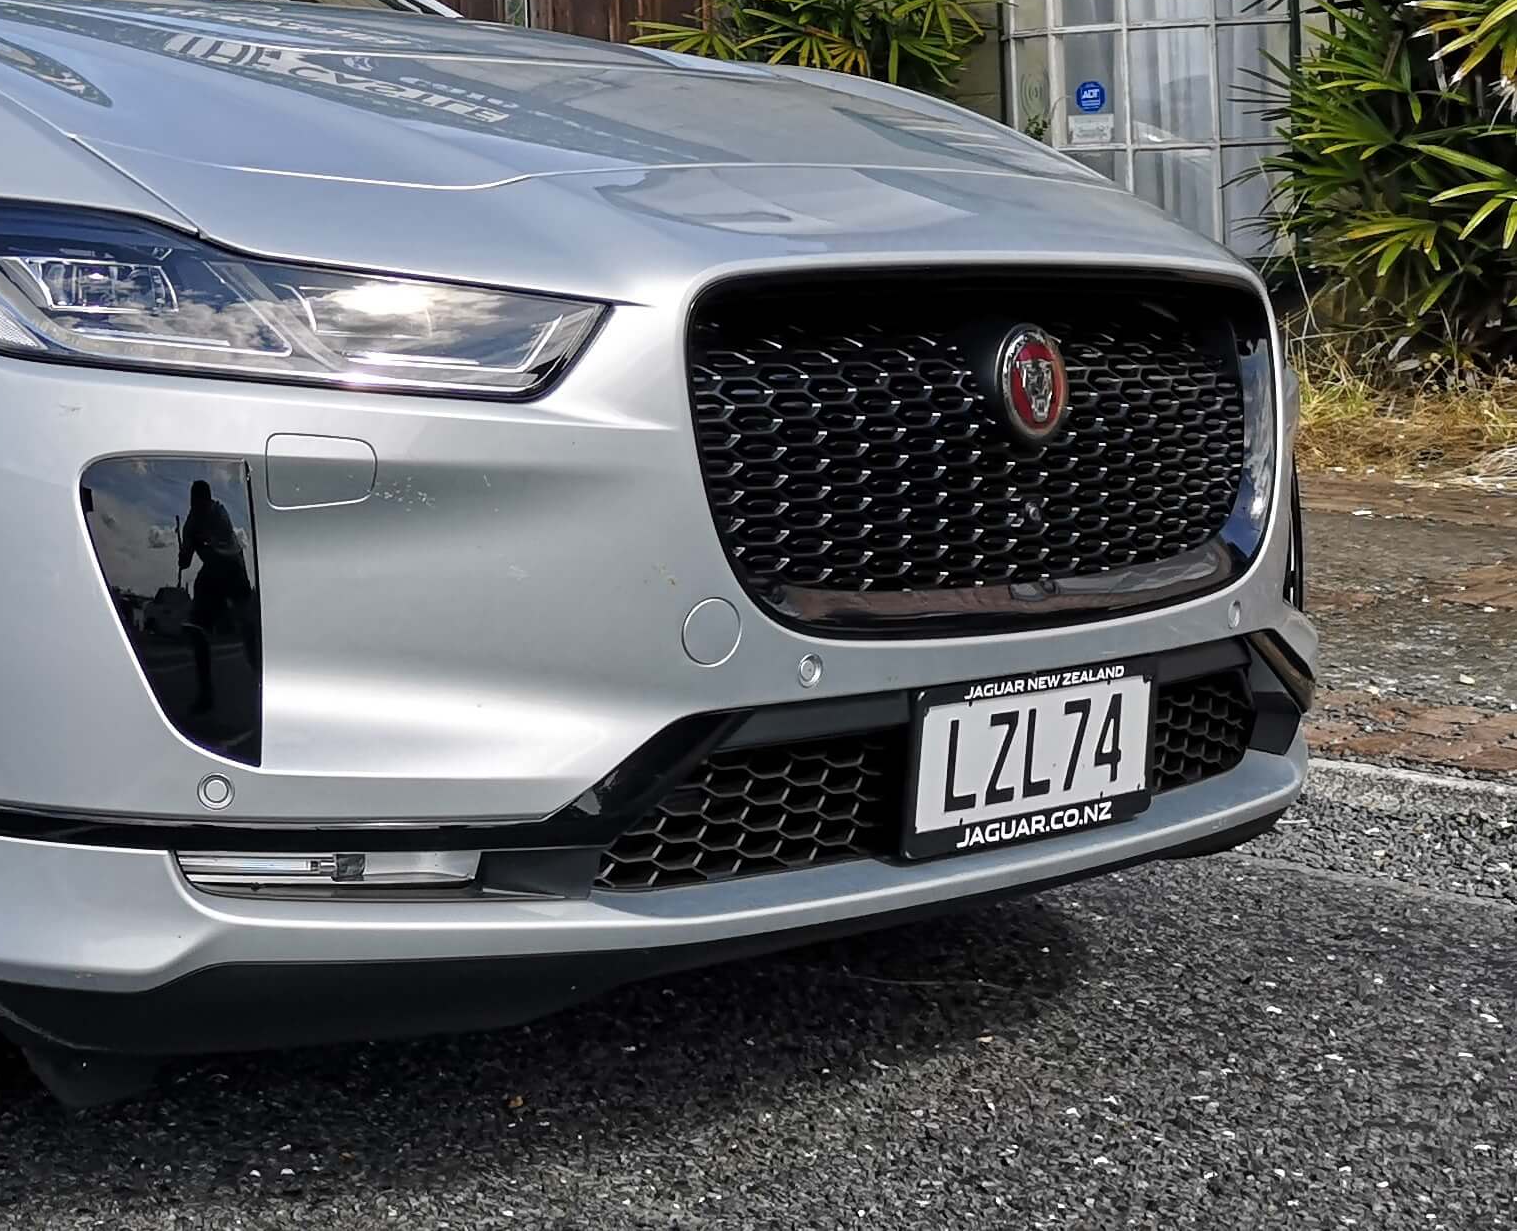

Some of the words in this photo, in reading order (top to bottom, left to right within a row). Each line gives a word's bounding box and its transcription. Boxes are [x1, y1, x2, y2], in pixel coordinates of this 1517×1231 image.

[964, 679, 1025, 700] JAGUAR
[1027, 674, 1062, 691] NEW
[1062, 665, 1125, 687] ZEALAND
[943, 692, 1123, 814] LZL74
[956, 801, 1113, 849] JAGUAR.CO.NZ
